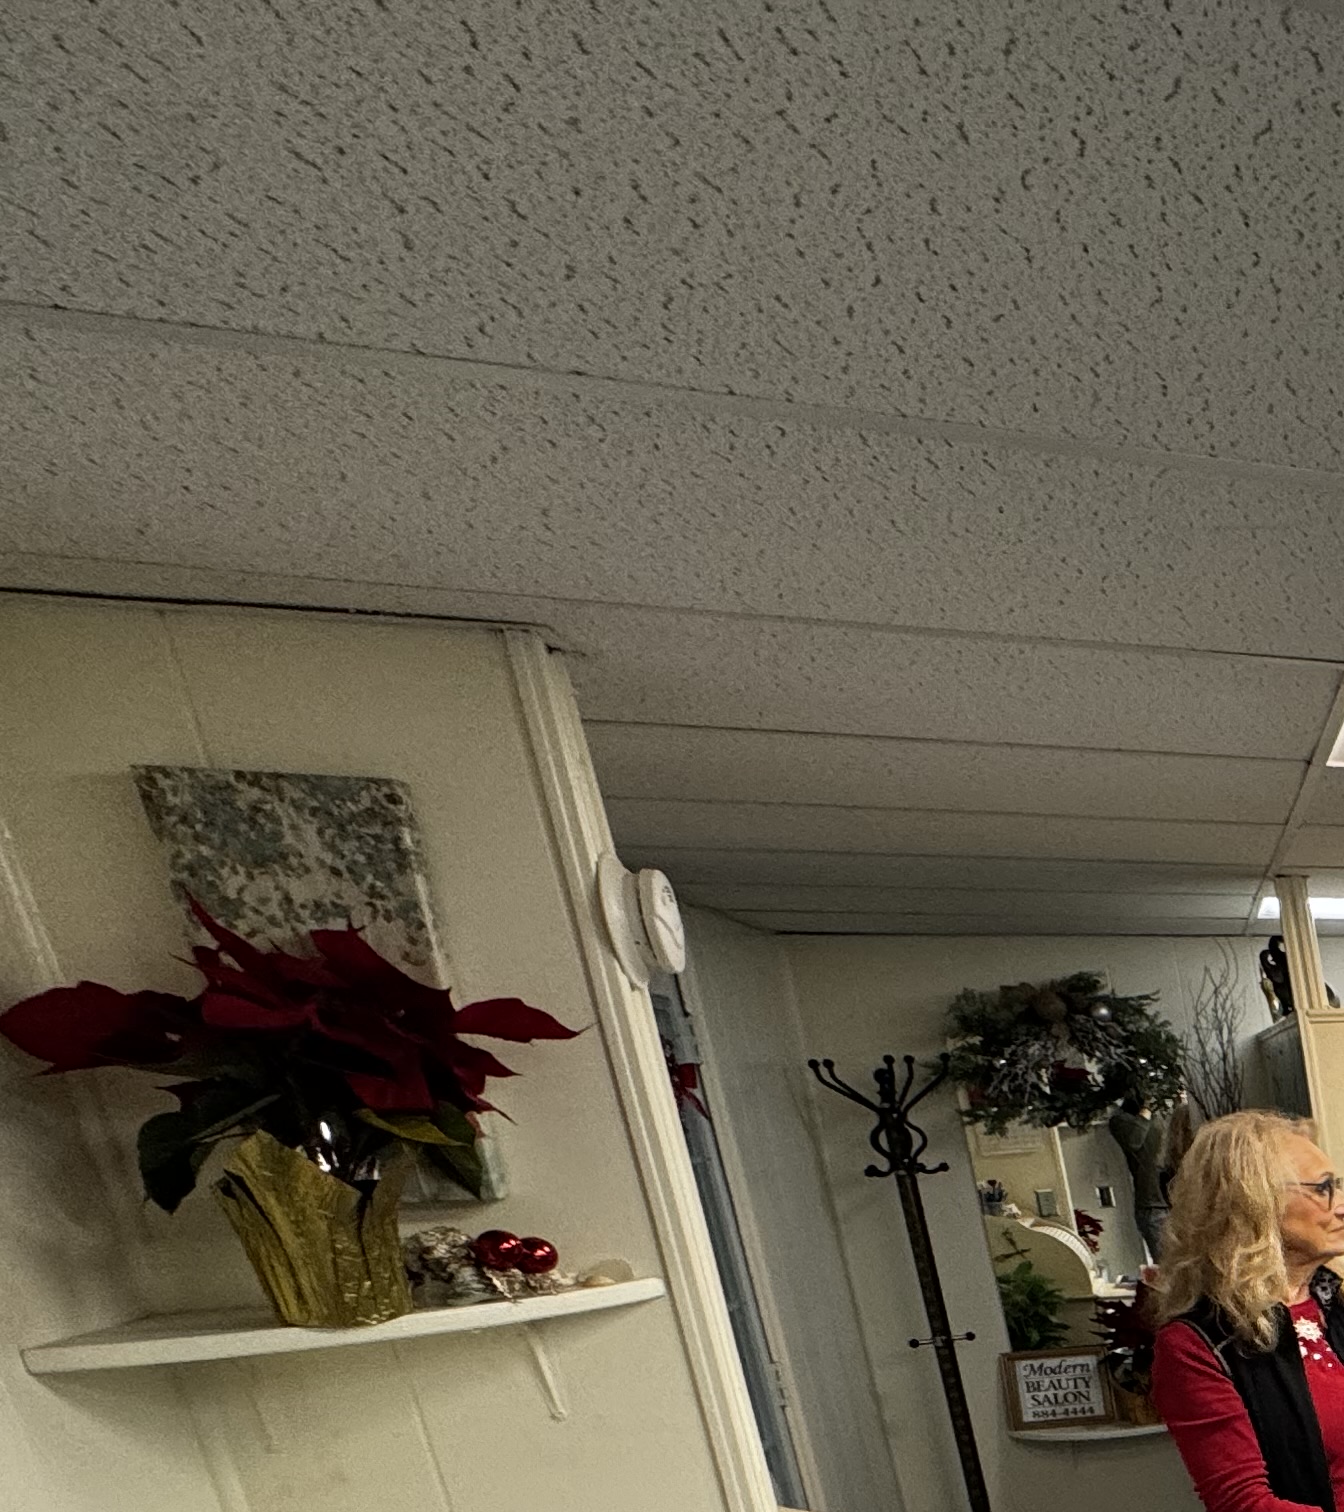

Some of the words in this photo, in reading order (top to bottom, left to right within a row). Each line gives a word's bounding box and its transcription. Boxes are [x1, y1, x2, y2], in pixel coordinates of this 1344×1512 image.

[1022, 1359, 1091, 1377] Modern
[1025, 1376, 1093, 1394] BEAUTY
[1031, 1390, 1091, 1407] SALON
[1032, 1406, 1095, 1419] 884-4444
